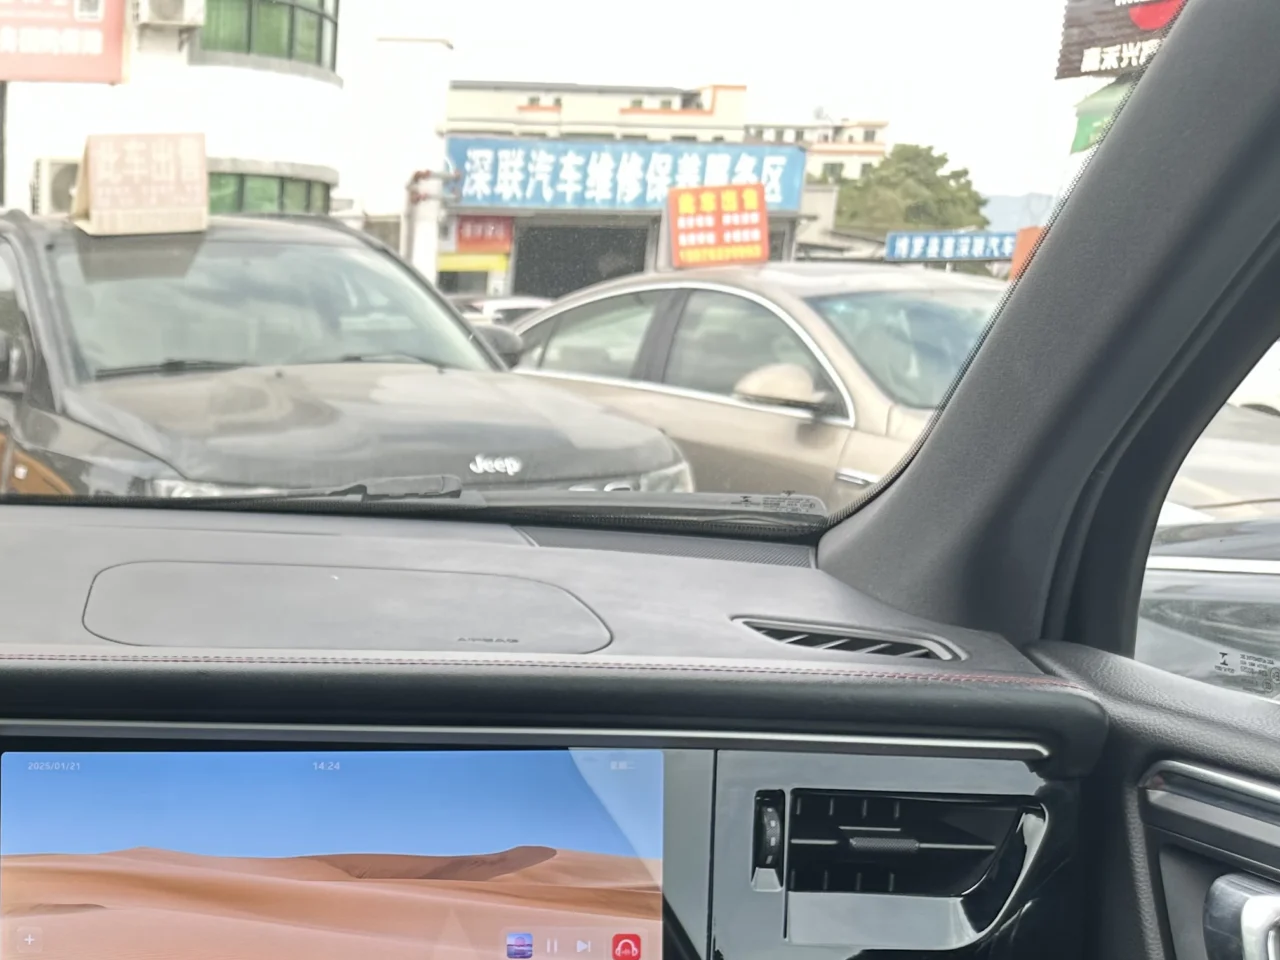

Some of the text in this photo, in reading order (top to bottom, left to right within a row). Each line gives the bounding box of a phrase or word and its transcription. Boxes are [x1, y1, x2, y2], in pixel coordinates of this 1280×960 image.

[469, 454, 523, 476] Jeep
[27, 762, 81, 771] 2025/01/21
[313, 761, 340, 771] 14:24
